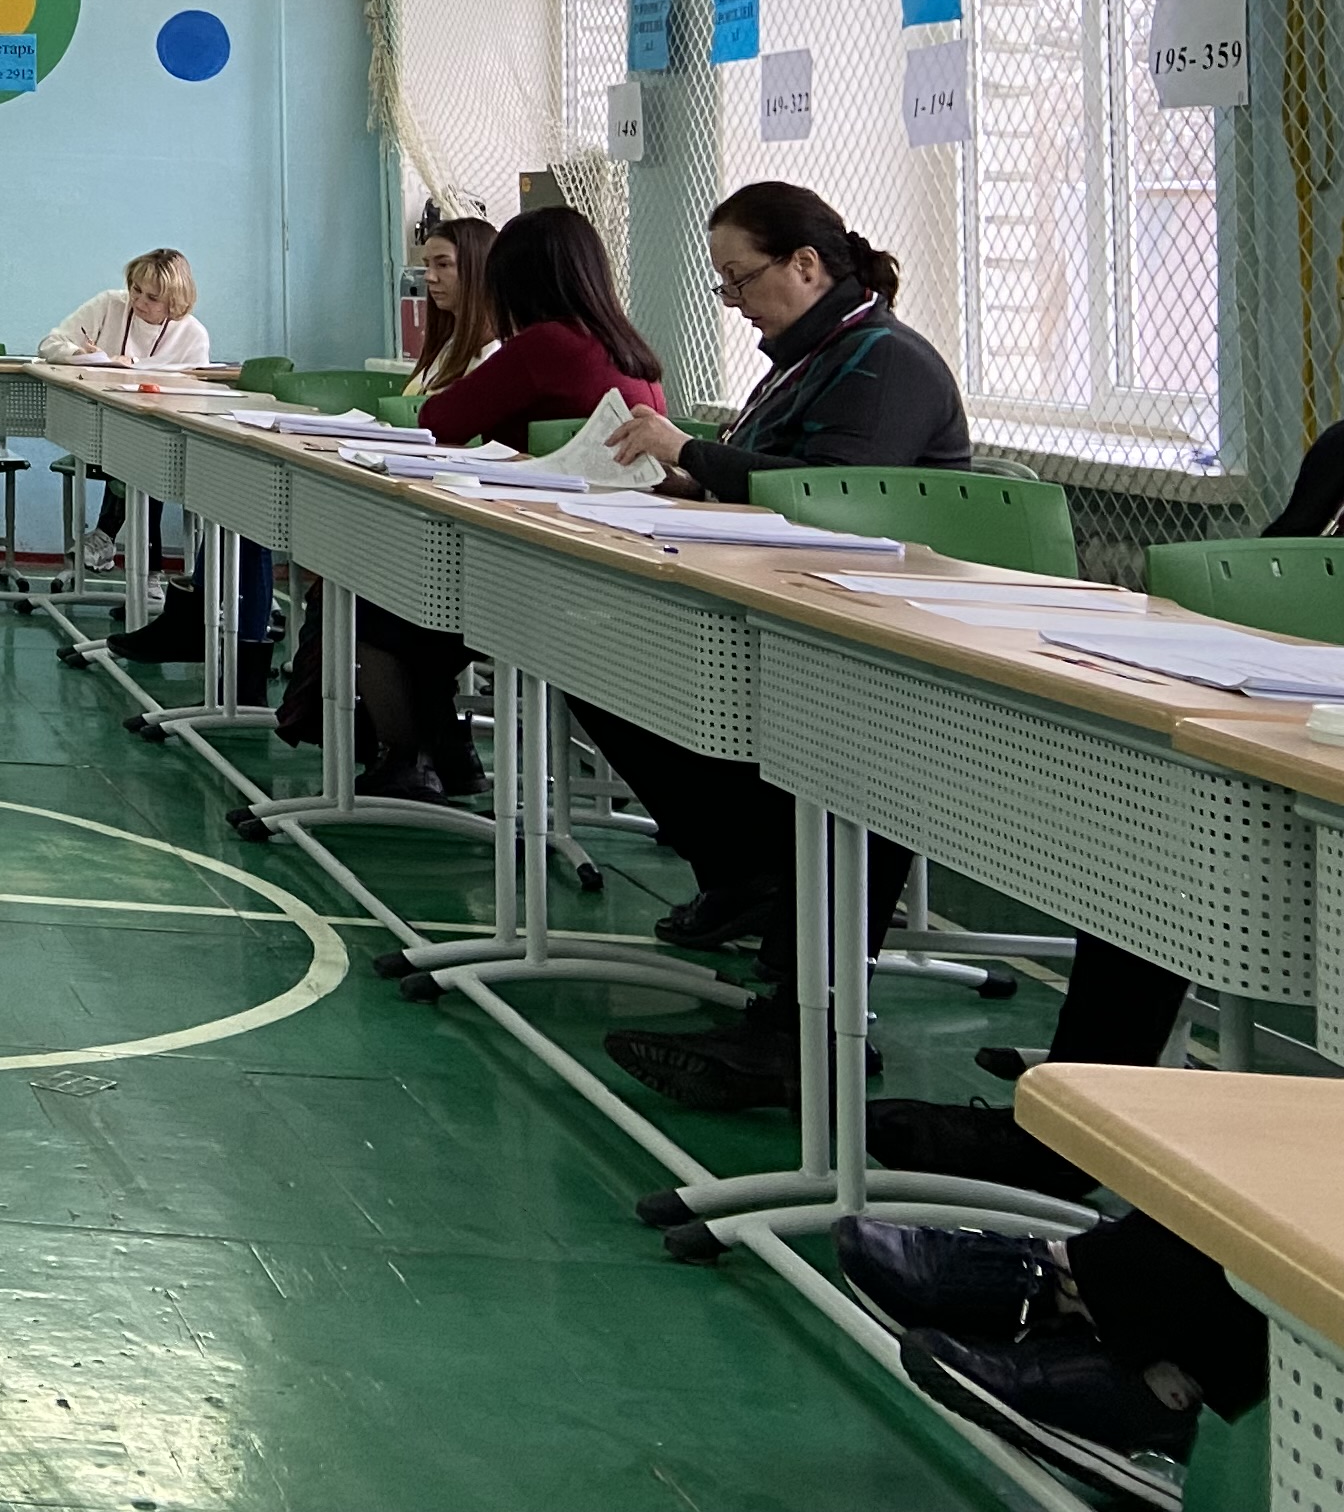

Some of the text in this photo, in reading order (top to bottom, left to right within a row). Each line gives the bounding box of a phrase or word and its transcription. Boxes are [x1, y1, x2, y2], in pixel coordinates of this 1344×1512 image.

[1155, 40, 1242, 76] 195-359
[6, 68, 34, 80] 2912
[914, 89, 954, 118] 1-194
